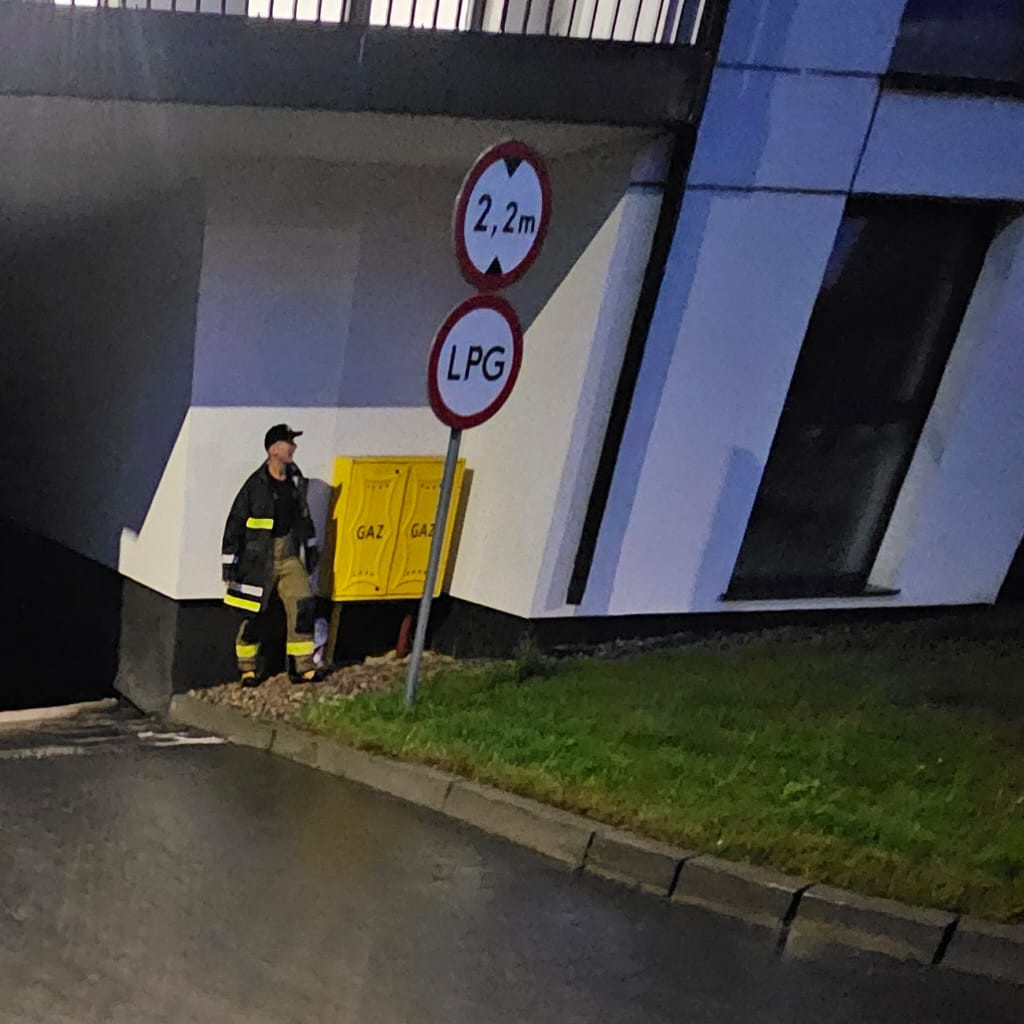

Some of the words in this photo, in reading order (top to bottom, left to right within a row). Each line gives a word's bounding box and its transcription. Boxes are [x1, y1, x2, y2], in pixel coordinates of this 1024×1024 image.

[473, 194, 536, 238] 2,2m
[447, 345, 506, 381] LPG
[356, 524, 384, 540] GAZ
[410, 522, 436, 538] GAZ
